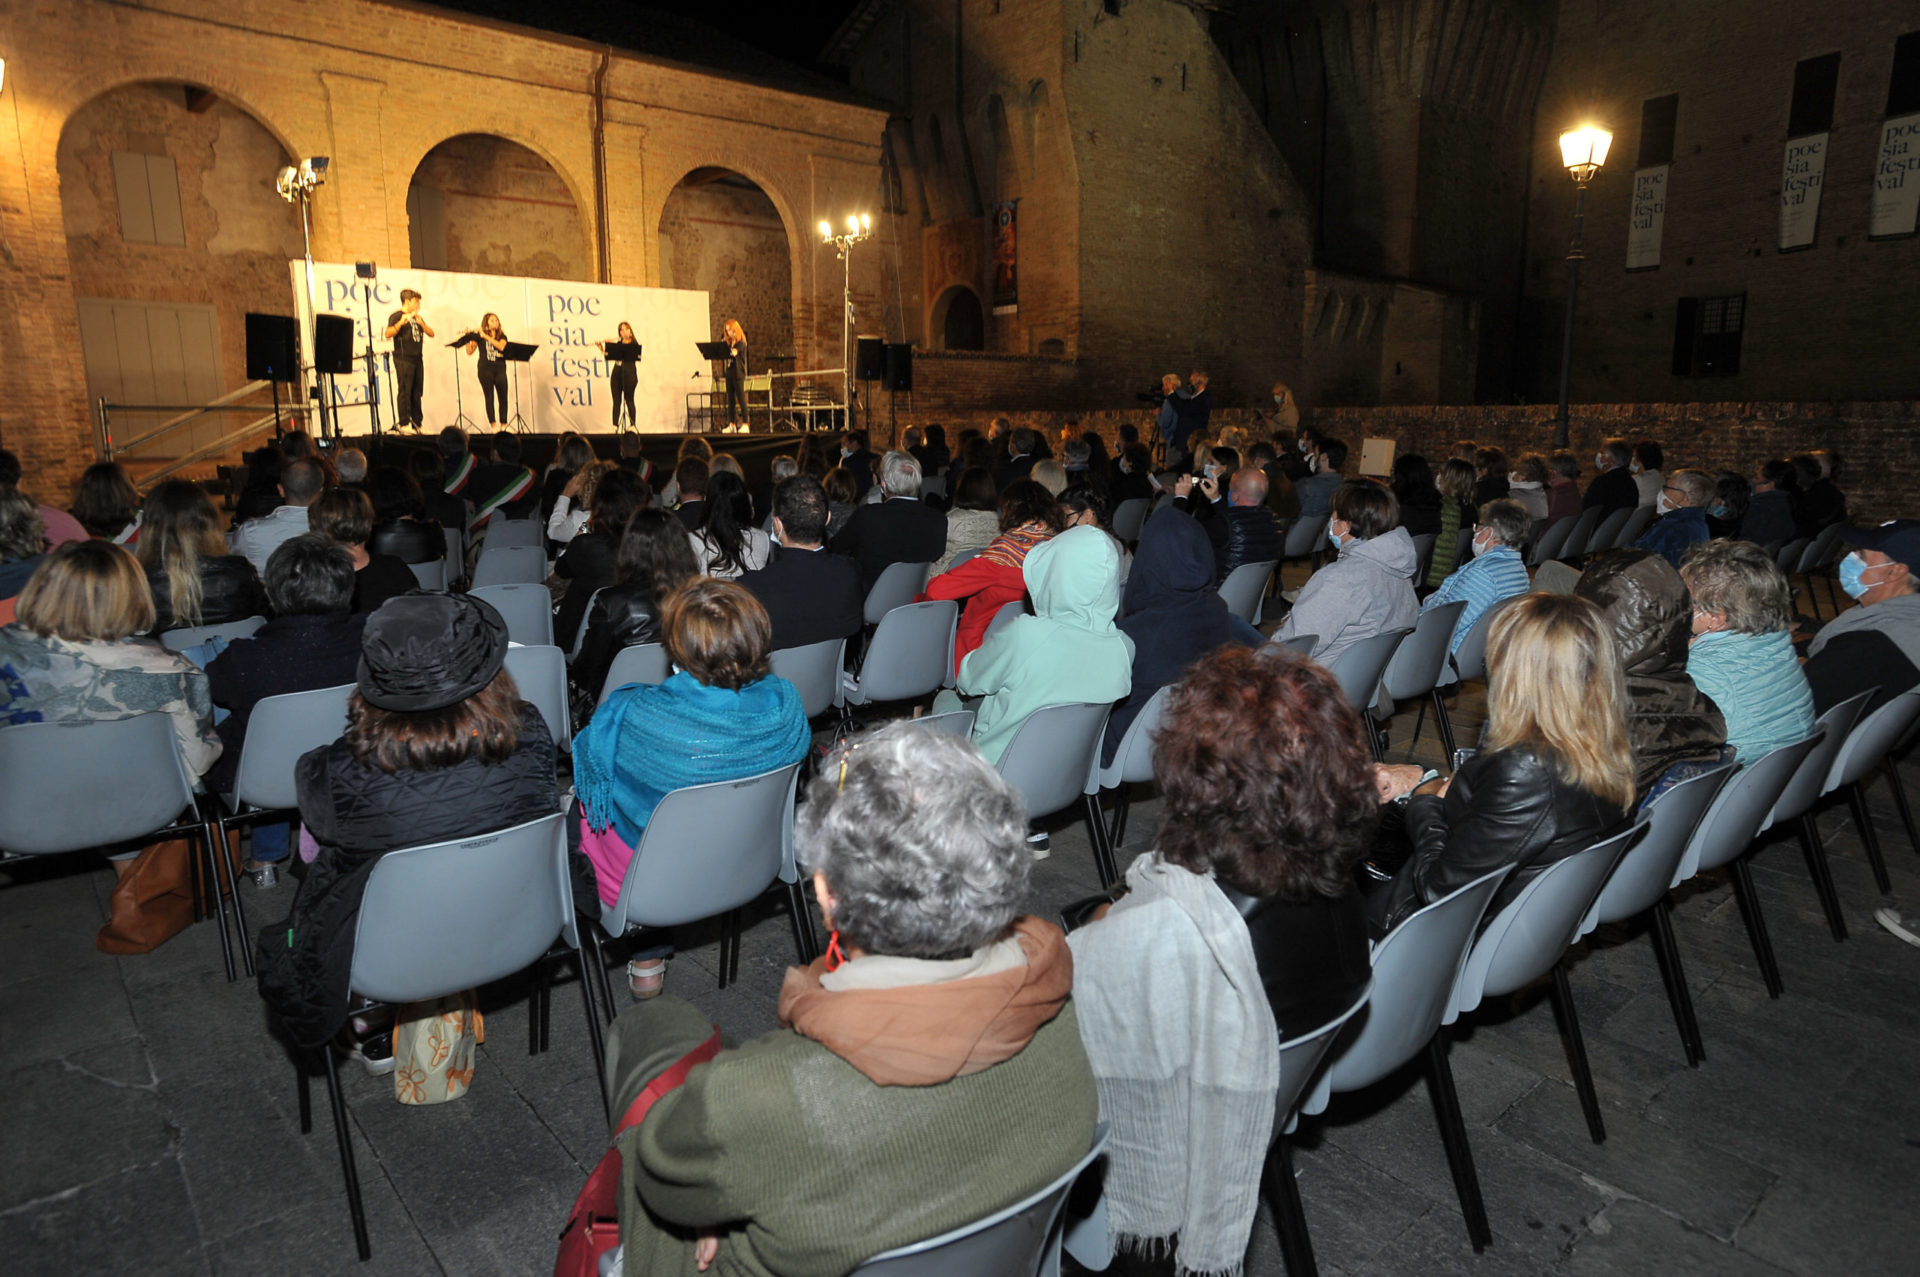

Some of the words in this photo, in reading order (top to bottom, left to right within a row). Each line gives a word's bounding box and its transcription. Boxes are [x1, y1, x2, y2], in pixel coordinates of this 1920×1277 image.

[1789, 143, 1821, 164] poe
[1883, 139, 1908, 156] sia
[1787, 159, 1809, 175] sia
[1637, 173, 1663, 191] poe
[1785, 171, 1821, 192] festi
[1877, 171, 1904, 190] val
[1635, 187, 1654, 202] sia
[1783, 188, 1806, 206] val
[1634, 200, 1664, 216] festi
[1633, 215, 1652, 230] val
[326, 279, 393, 311] poe
[547, 295, 601, 322] poe
[549, 319, 588, 347] sia
[553, 379, 592, 406] val
